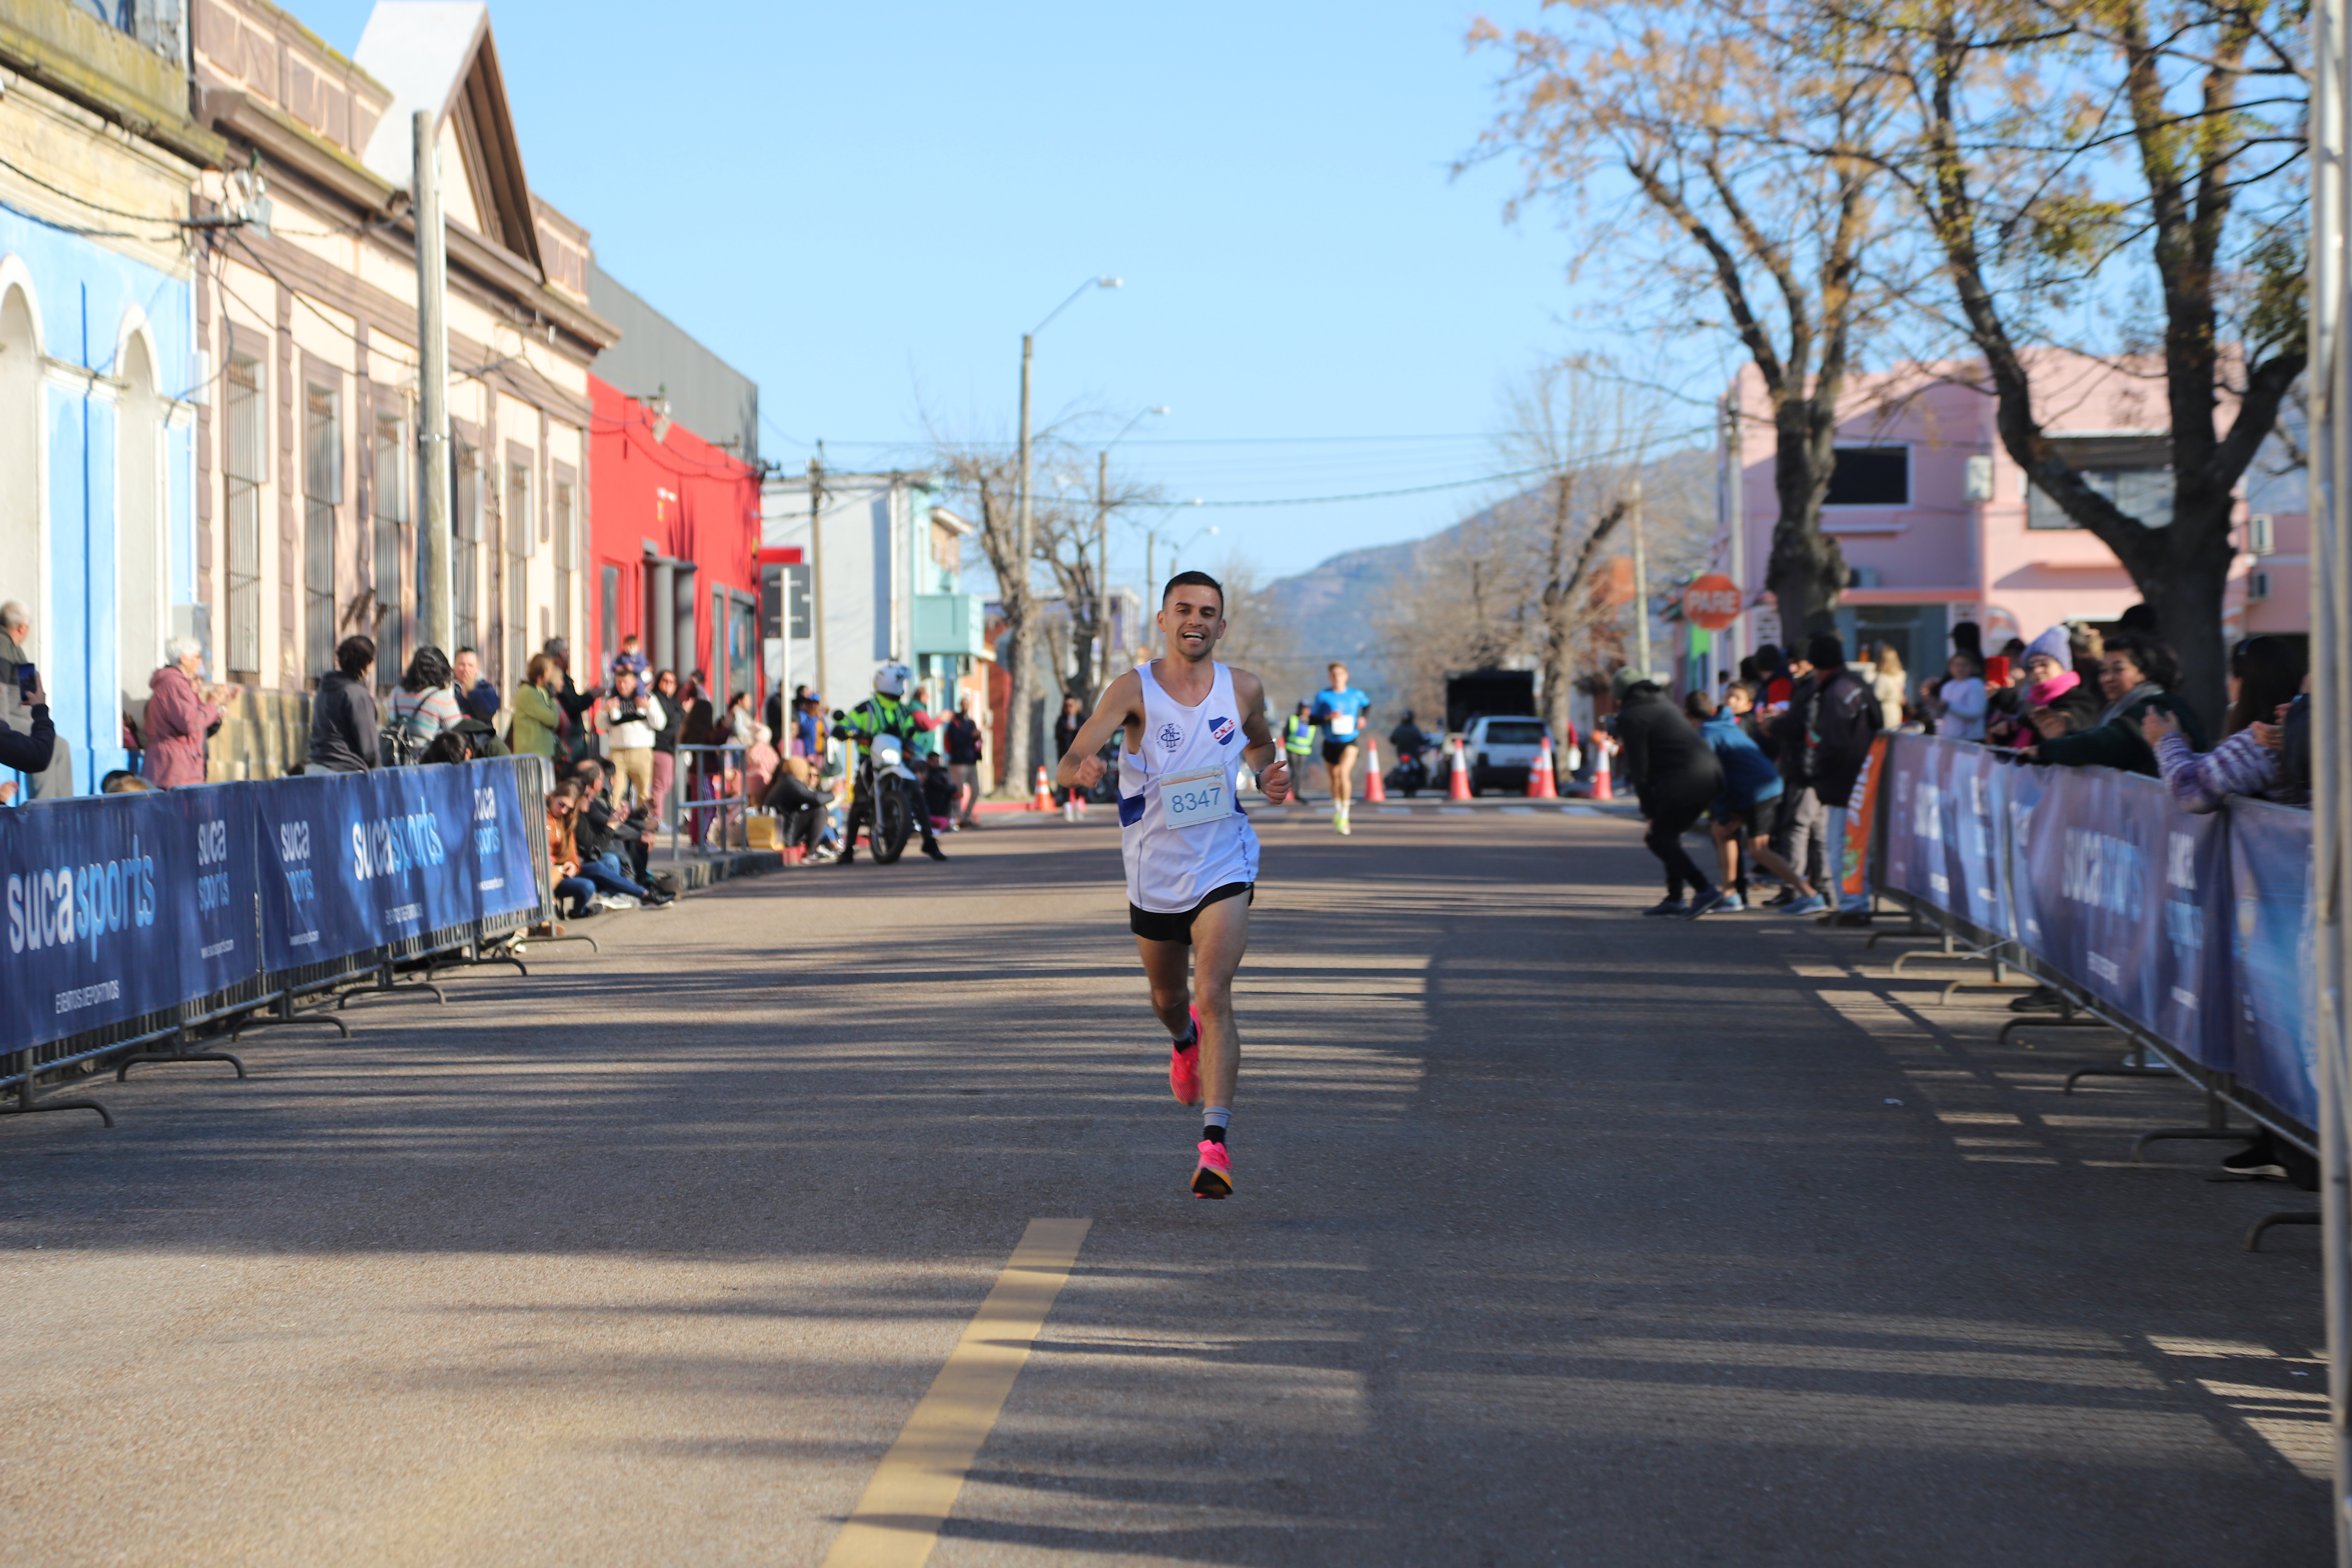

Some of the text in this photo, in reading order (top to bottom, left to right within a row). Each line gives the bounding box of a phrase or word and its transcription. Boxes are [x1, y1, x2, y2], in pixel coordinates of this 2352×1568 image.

[1689, 590, 1737, 614] PARE
[1172, 787, 1221, 813] 8347
[198, 819, 226, 866] suca
[280, 821, 310, 863] suca
[352, 796, 445, 890] sucasports
[7, 834, 156, 963] sucasports
[198, 862, 230, 921] sports
